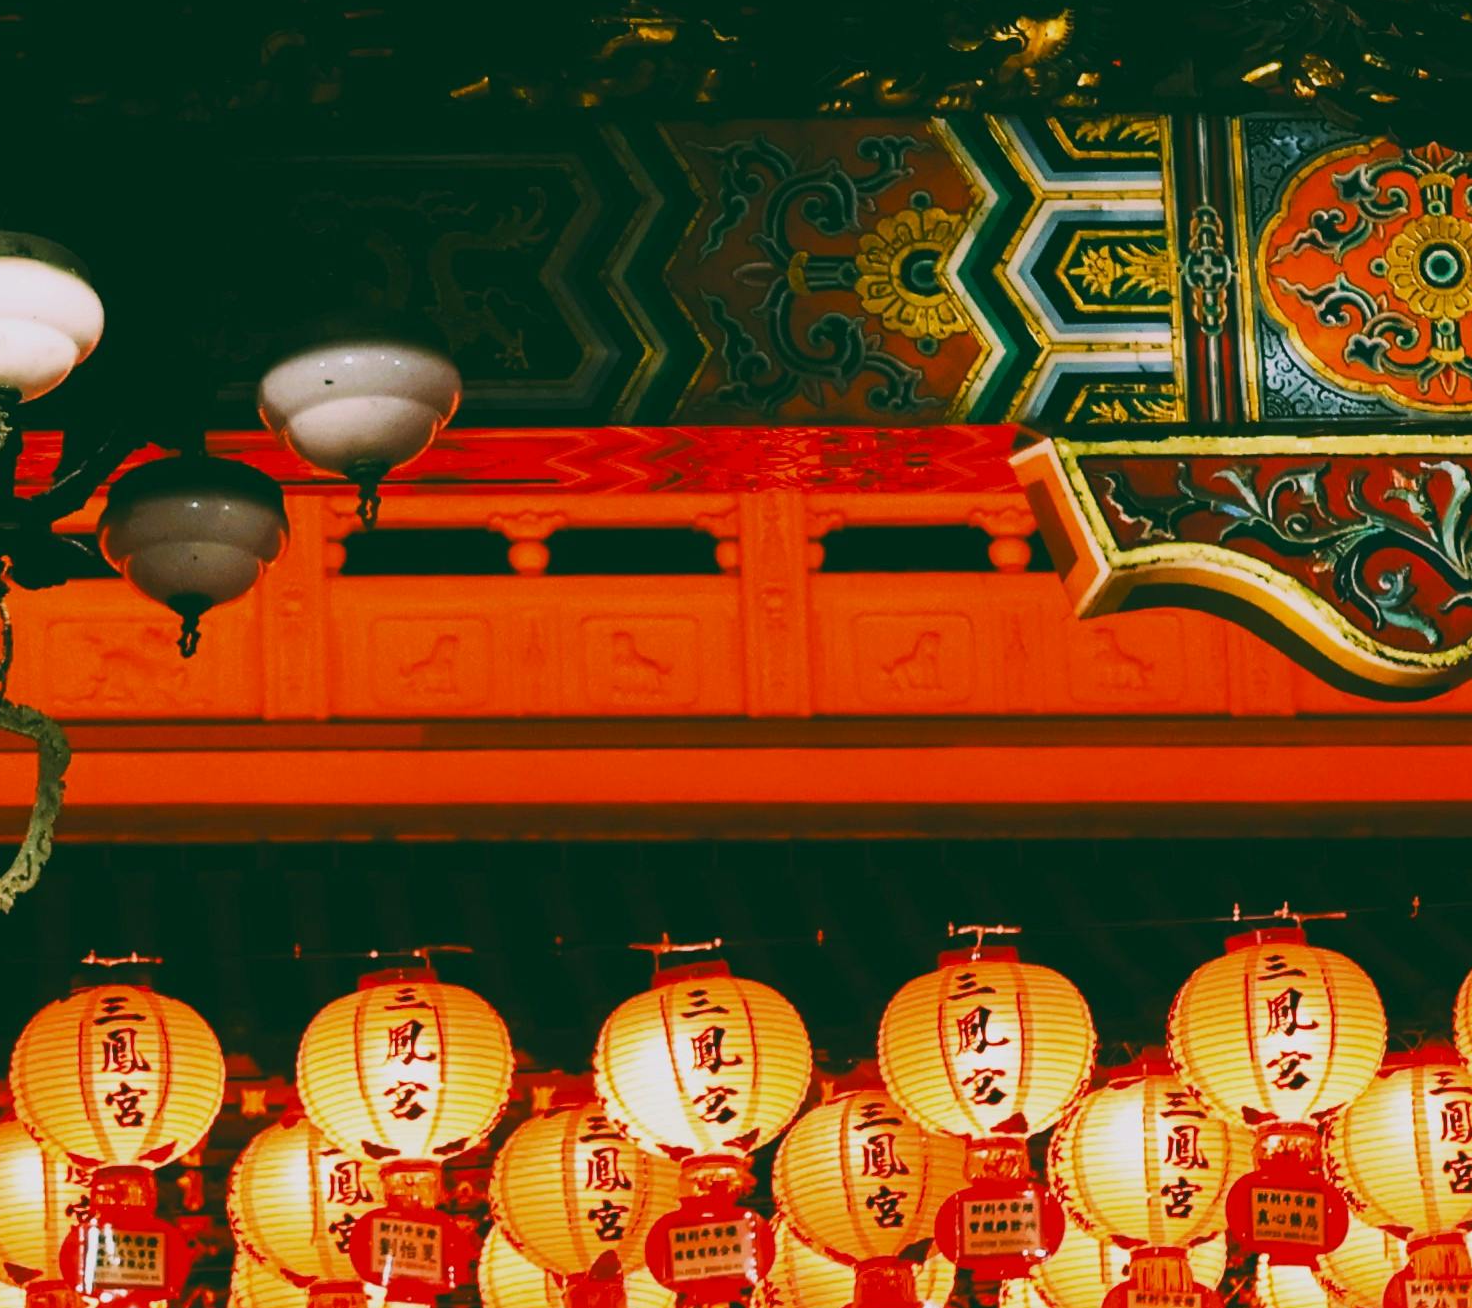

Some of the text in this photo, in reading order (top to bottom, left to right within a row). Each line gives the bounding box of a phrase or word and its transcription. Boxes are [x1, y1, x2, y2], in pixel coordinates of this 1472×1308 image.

[93, 997, 150, 1126] 三鳳宮
[383, 988, 437, 1120] 三鳳宮
[682, 989, 744, 1124] 三鳳宮
[947, 973, 1010, 1105] 三鳳宮
[1258, 955, 1319, 1090] 三鳳宮
[579, 1116, 632, 1242] 三鳳宮
[854, 1102, 910, 1229] 三鳳宮
[1160, 1091, 1210, 1219] 三鳳宮
